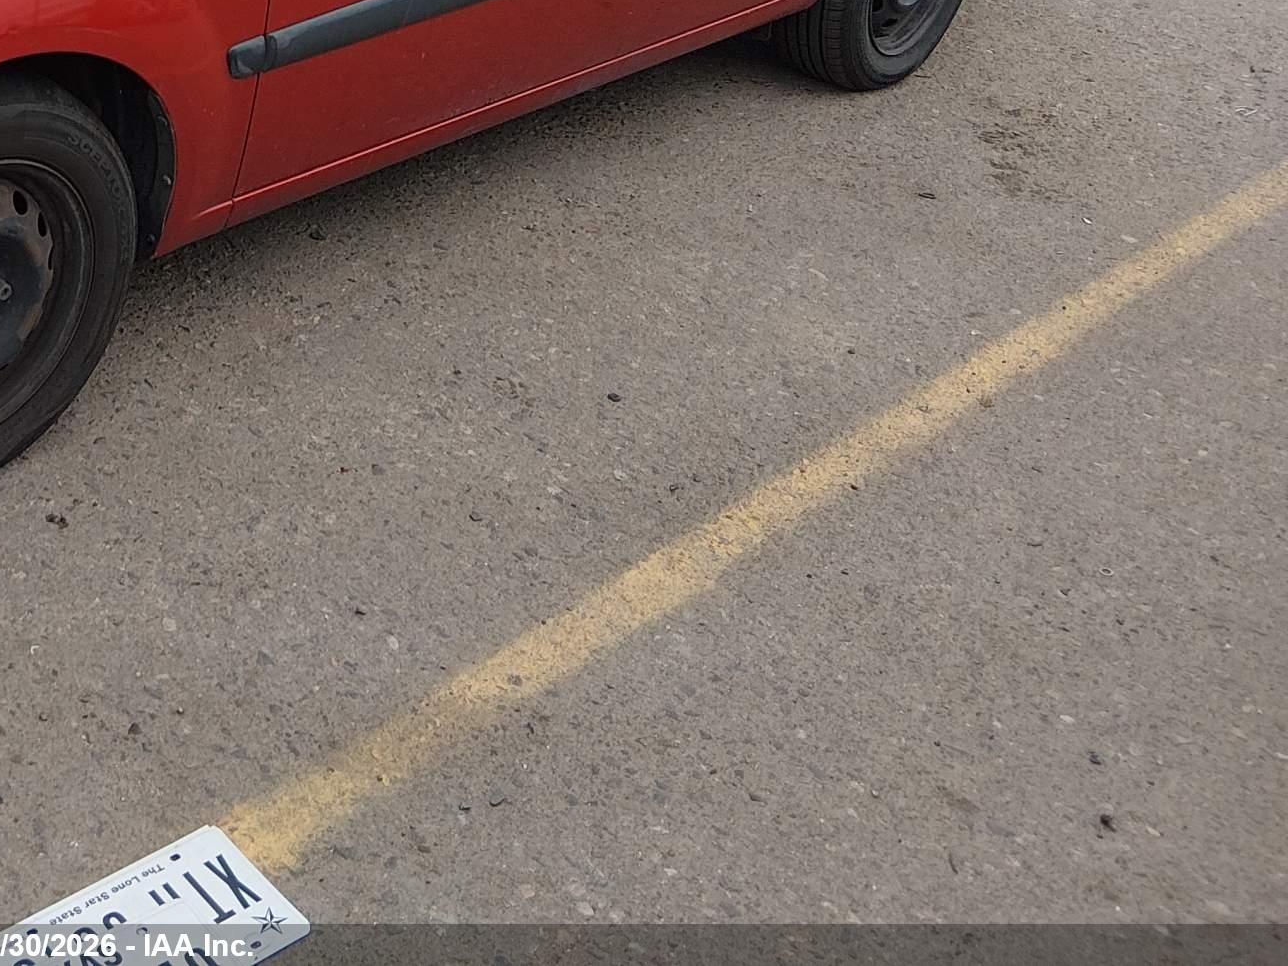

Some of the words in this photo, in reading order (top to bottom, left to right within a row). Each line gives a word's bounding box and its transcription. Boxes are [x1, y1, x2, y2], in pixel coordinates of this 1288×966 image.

[141, 864, 165, 878] The
[111, 876, 141, 894] Lone
[84, 891, 110, 909] Star
[48, 906, 83, 926] State
